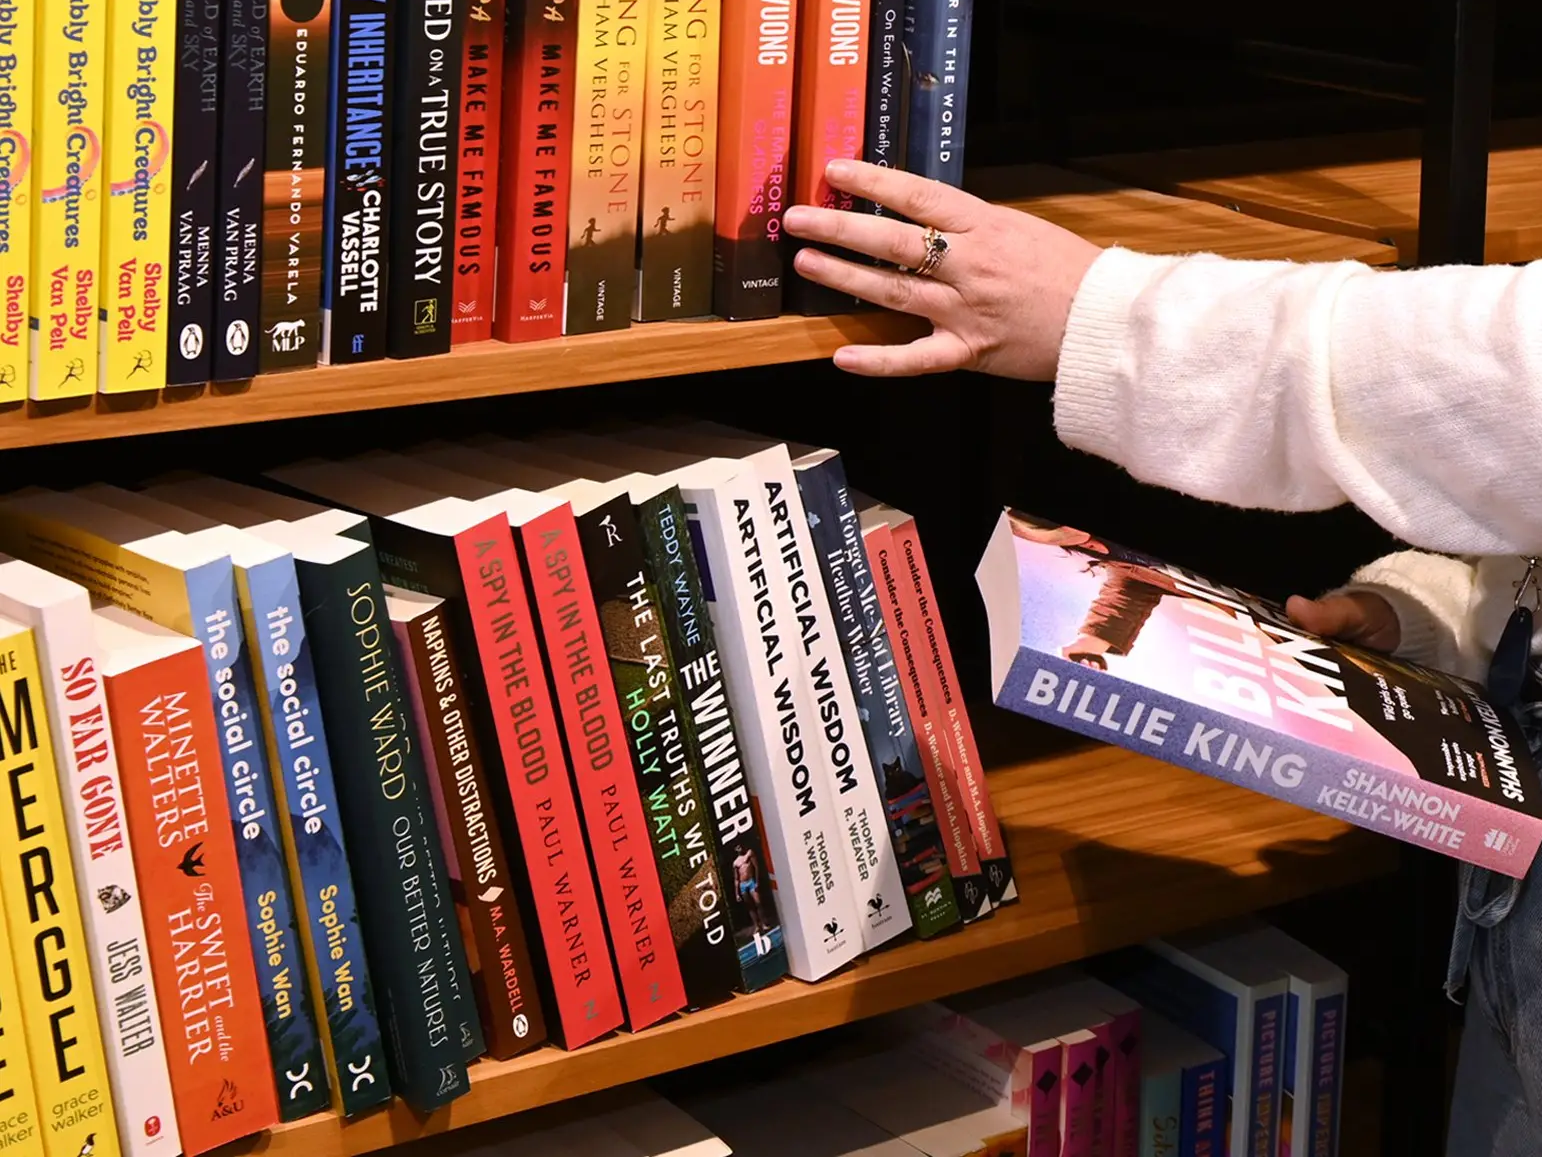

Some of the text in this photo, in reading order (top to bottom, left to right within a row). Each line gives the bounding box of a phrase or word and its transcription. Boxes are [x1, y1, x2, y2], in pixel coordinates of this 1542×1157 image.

[184, 0, 199, 72] and SKY
[201, 47, 220, 112] EARTH
[617, 61, 630, 96] FOR
[944, 48, 957, 85] THE
[945, 18, 959, 39] IN
[58, 51, 88, 125] Bright
[345, 13, 386, 170] INHERITANCE
[588, 58, 608, 179] VERGHESE
[938, 94, 954, 164] WORLD
[65, 133, 86, 248] Creatures
[287, 29, 308, 305] EDUARDO FERNANDO VARELA
[458, 44, 488, 275] MAKE ME FAMOUS
[607, 108, 633, 214] STONE
[768, 126, 785, 213] EMPEROR
[177, 211, 194, 305] VAN PRAAG
[196, 226, 210, 287] MENNA
[340, 210, 361, 297] VASSELL
[360, 190, 381, 314] CHARLOTTE
[742, 277, 779, 289] VINTAGE
[767, 218, 780, 242] OF
[0, 276, 24, 346] Shelby
[50, 265, 69, 351] Van Pelt
[658, 504, 700, 647] TEDDY WAYNE
[827, 549, 873, 695] Heather Webber
[838, 509, 886, 659] Forget-Me-Not
[878, 659, 906, 737] Library
[348, 582, 407, 800] SOPHIE WARD
[475, 539, 549, 786] A SPY IN THE BLOOD
[733, 499, 816, 818] ARTIFICIAL WISDOM
[879, 549, 928, 718] Consider the Consequences
[60, 657, 125, 860] SO FAR GONE
[139, 696, 182, 848] WALTERS
[163, 691, 208, 843] MINETTE
[205, 609, 265, 840] the social circle
[422, 614, 497, 884] NAPKINS & OTHER DISTRACTIONS
[626, 571, 725, 946] THE LAST TRUTHS WE TOLD
[626, 688, 680, 860] HOLLY WATT
[680, 650, 753, 845] THE WINNER
[1023, 668, 1308, 789] BILLIE KING
[1316, 785, 1466, 851] KELLY-WHITE
[1342, 767, 1462, 823] SHANNON
[536, 798, 592, 988] PAUL WARNER
[803, 830, 825, 907] R. WEAVER
[815, 831, 834, 891] THOMAS
[168, 908, 214, 1065] HARRIER
[197, 912, 234, 1010] SWIFT
[257, 890, 293, 1020] Sophie Wan
[392, 815, 449, 1048] OUR BETTER NATURES
[489, 906, 523, 1013] M.A. WARDELL
[107, 938, 155, 1057] JESS WALTER
[1257, 1009, 1277, 1089] PICTURE
[51, 1102, 104, 1133] walker
[52, 1087, 99, 1118] grace
[211, 1100, 244, 1121] A&U
